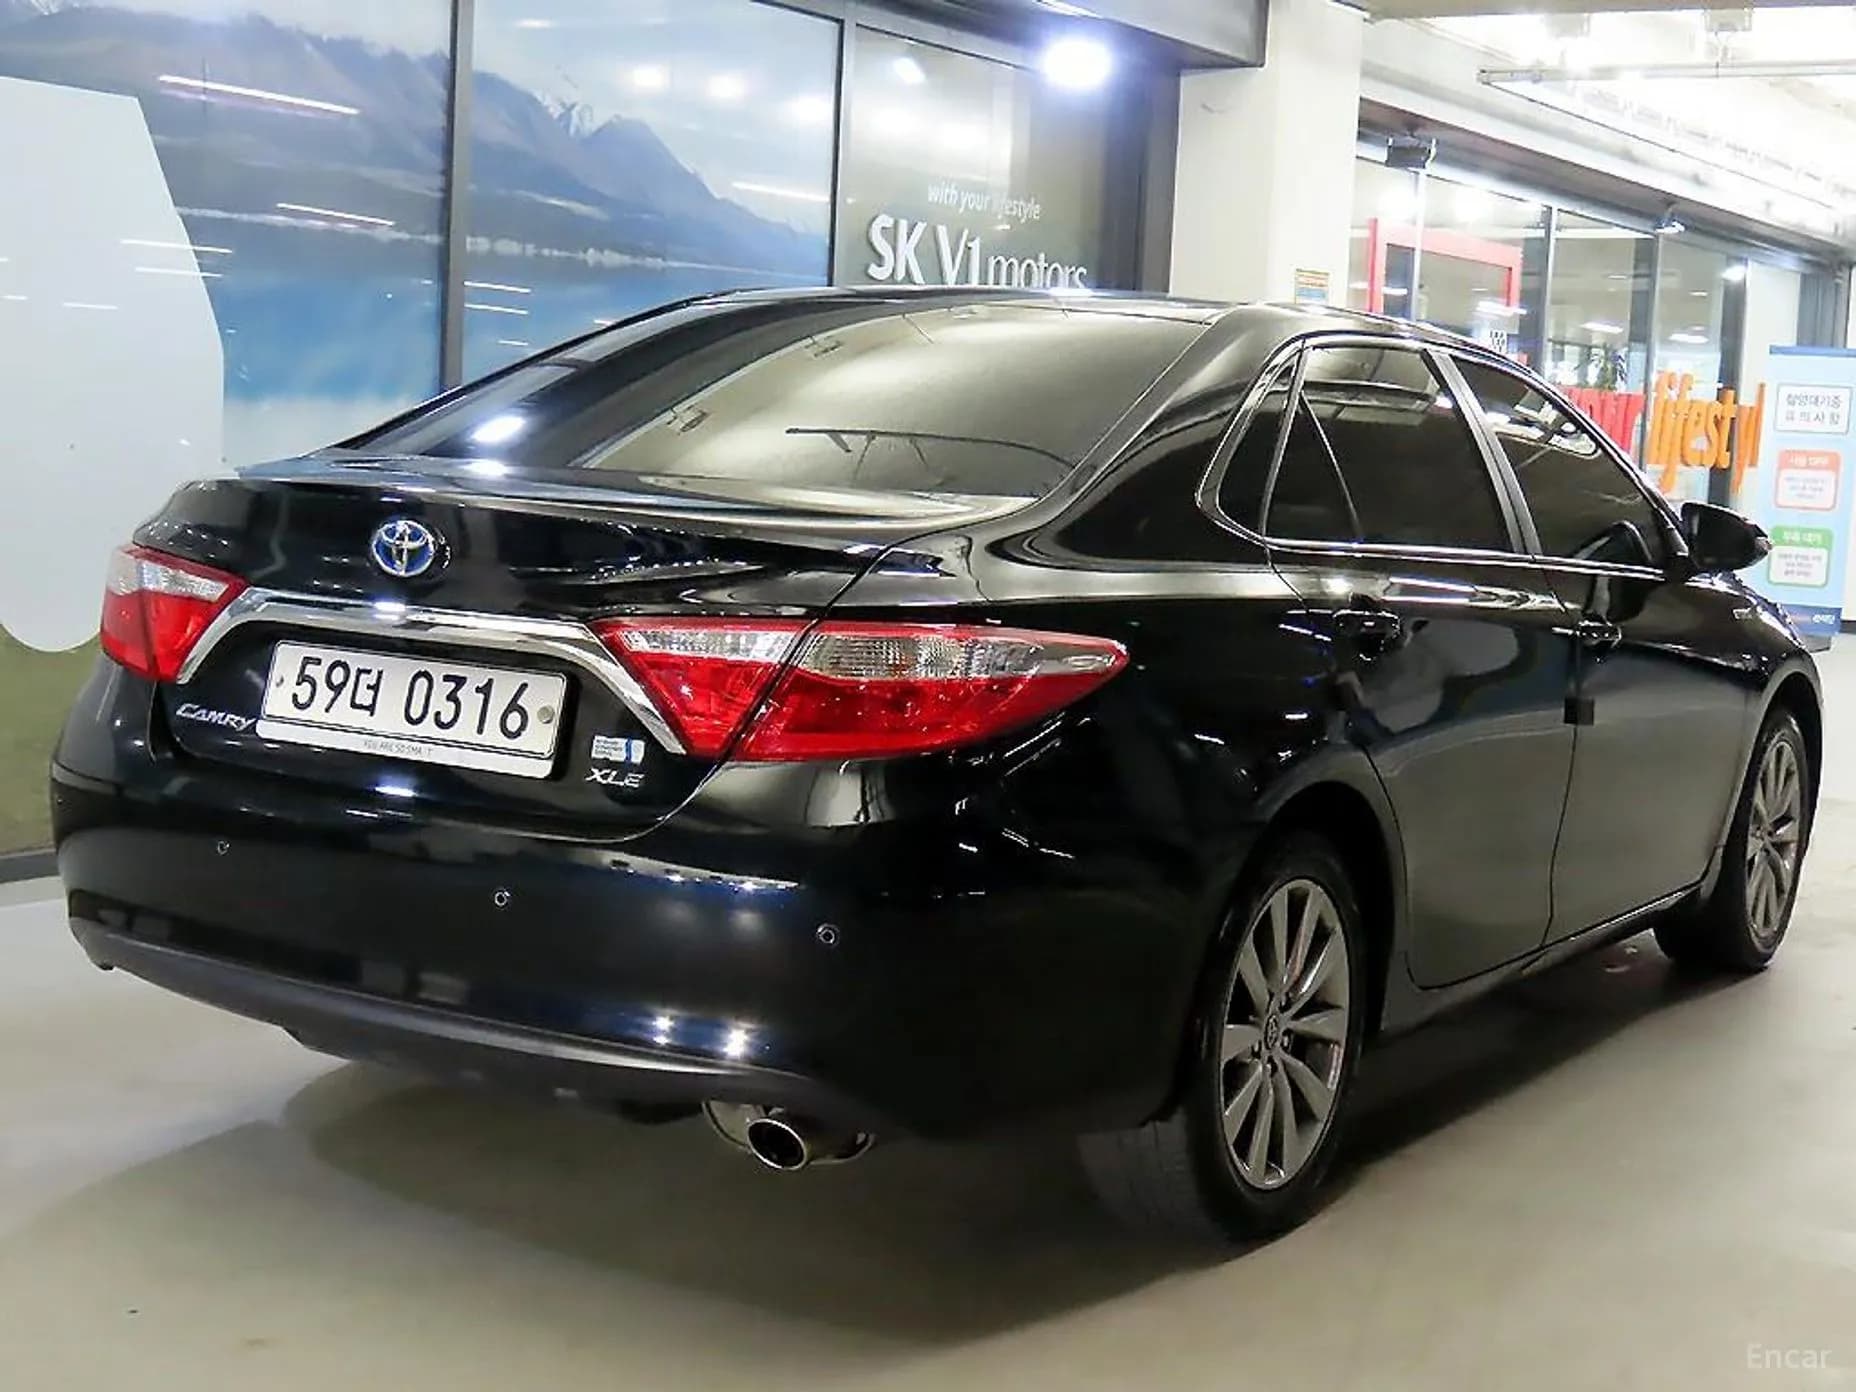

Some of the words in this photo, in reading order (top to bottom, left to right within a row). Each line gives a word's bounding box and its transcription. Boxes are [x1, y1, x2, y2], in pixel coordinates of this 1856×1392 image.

[927, 181, 959, 205] with
[960, 191, 991, 215] your
[867, 213, 927, 285] SK
[291, 655, 384, 717] 59더
[403, 669, 529, 740] 0316
[175, 703, 257, 731] CAMRY
[584, 767, 645, 788] XLE
